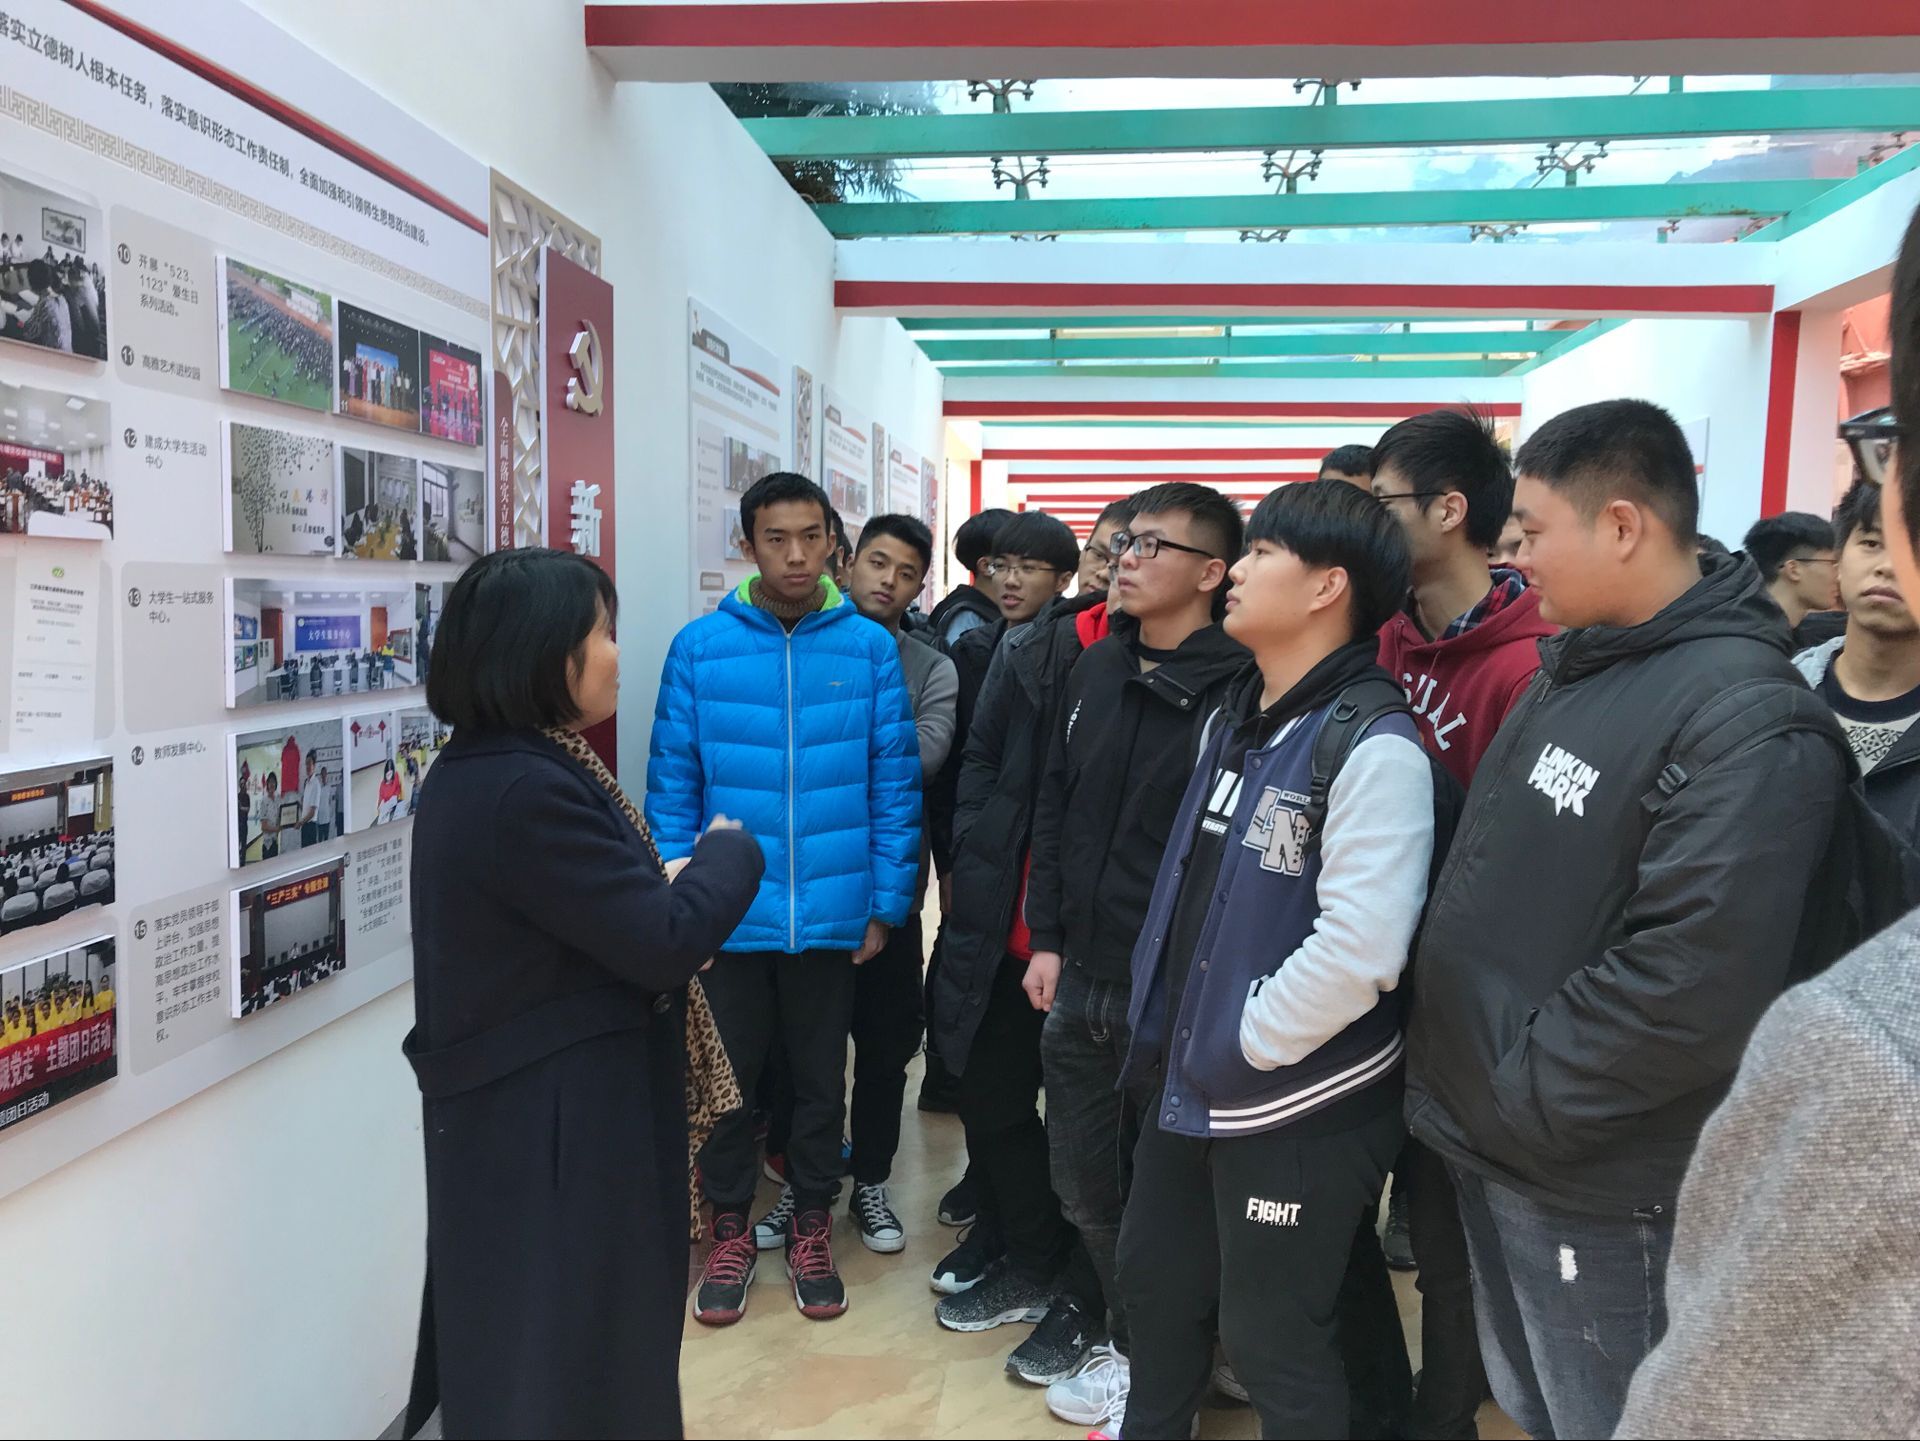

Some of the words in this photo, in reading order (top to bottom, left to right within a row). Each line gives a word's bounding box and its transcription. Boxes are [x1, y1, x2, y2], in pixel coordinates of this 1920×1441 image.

[571, 480, 602, 557] 新
[1527, 761, 1590, 817] PARK
[1538, 742, 1600, 791] LINKIN
[1246, 1197, 1302, 1223] FIGHT
